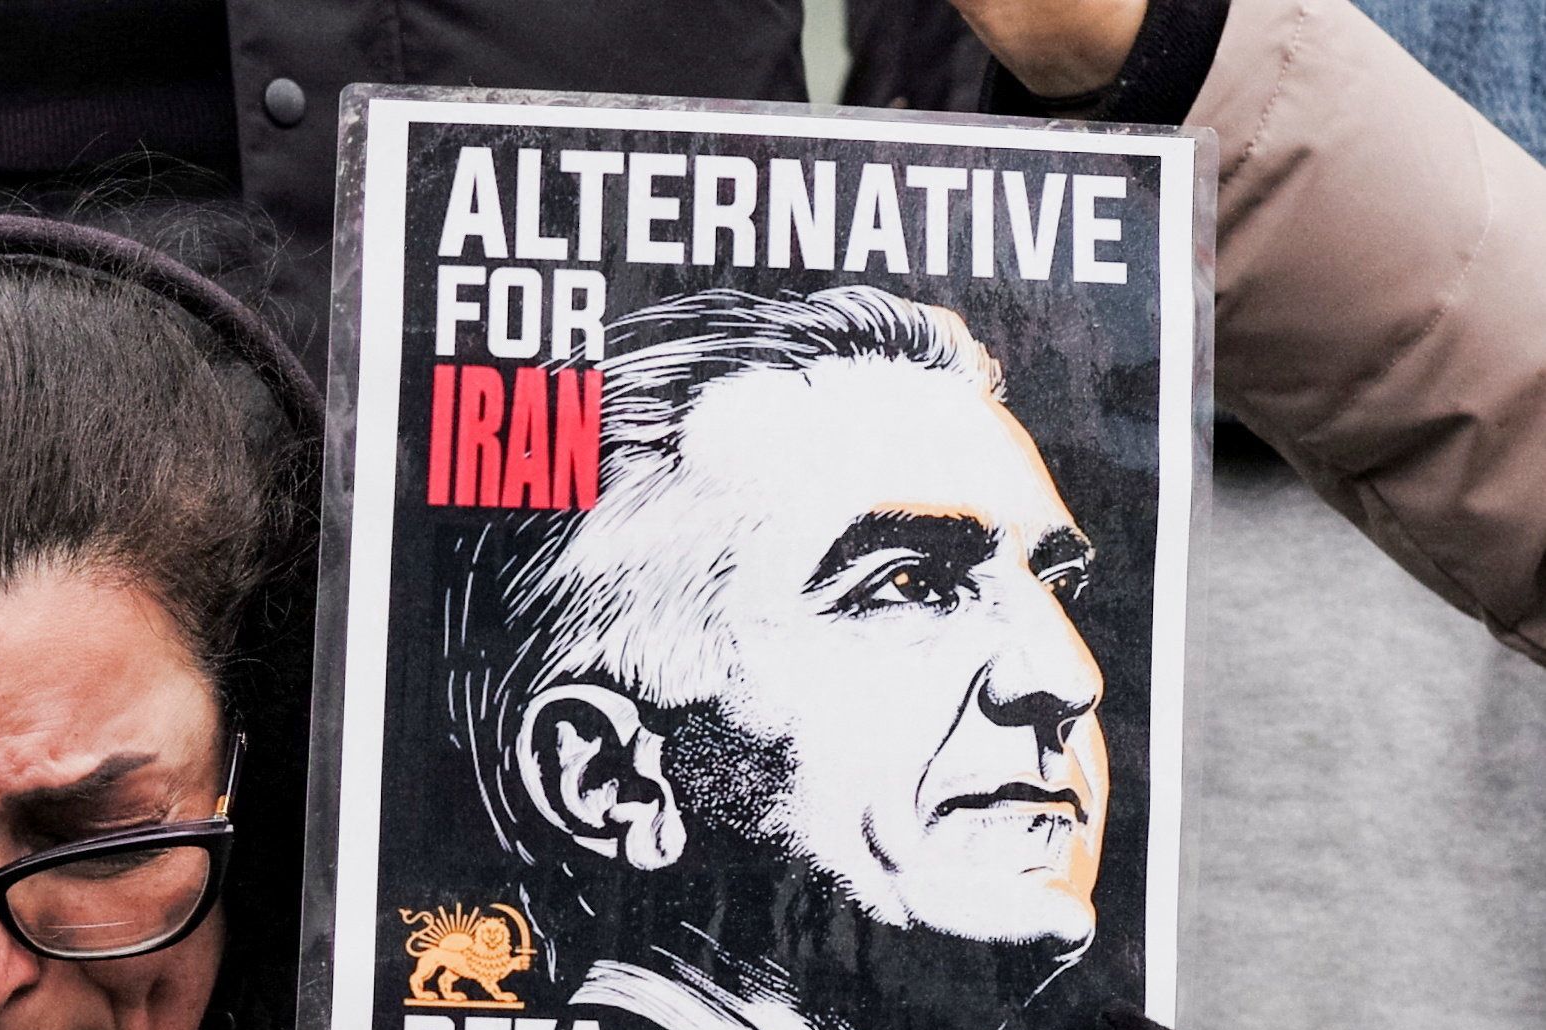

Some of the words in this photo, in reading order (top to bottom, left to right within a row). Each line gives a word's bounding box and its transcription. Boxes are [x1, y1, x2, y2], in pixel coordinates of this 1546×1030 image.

[437, 146, 1128, 285] ALTERNATIVE
[435, 264, 606, 362] FOR
[428, 364, 603, 511] IRAN
